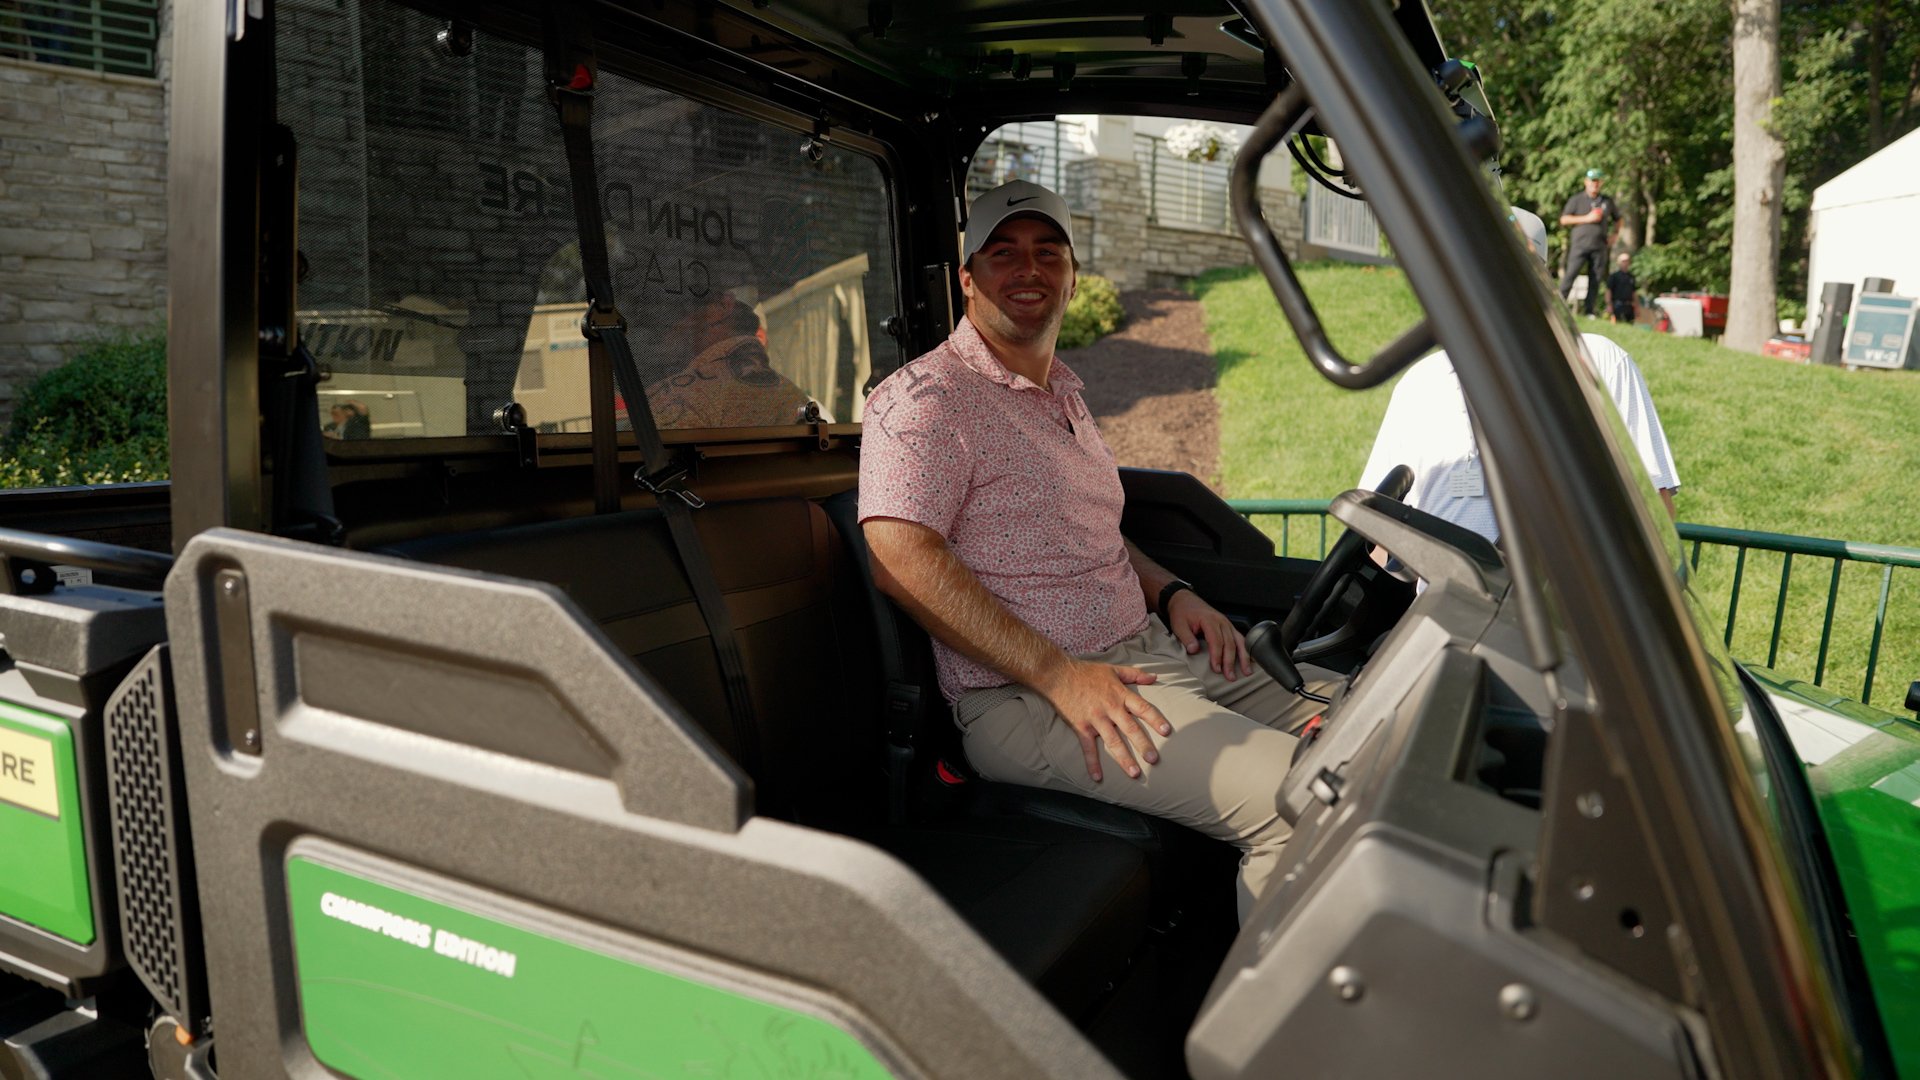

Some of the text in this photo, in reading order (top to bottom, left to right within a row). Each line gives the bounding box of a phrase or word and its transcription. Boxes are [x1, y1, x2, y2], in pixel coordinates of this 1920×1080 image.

[1, 751, 36, 786] RE
[320, 892, 517, 978] CHAMPIONS EDITION
